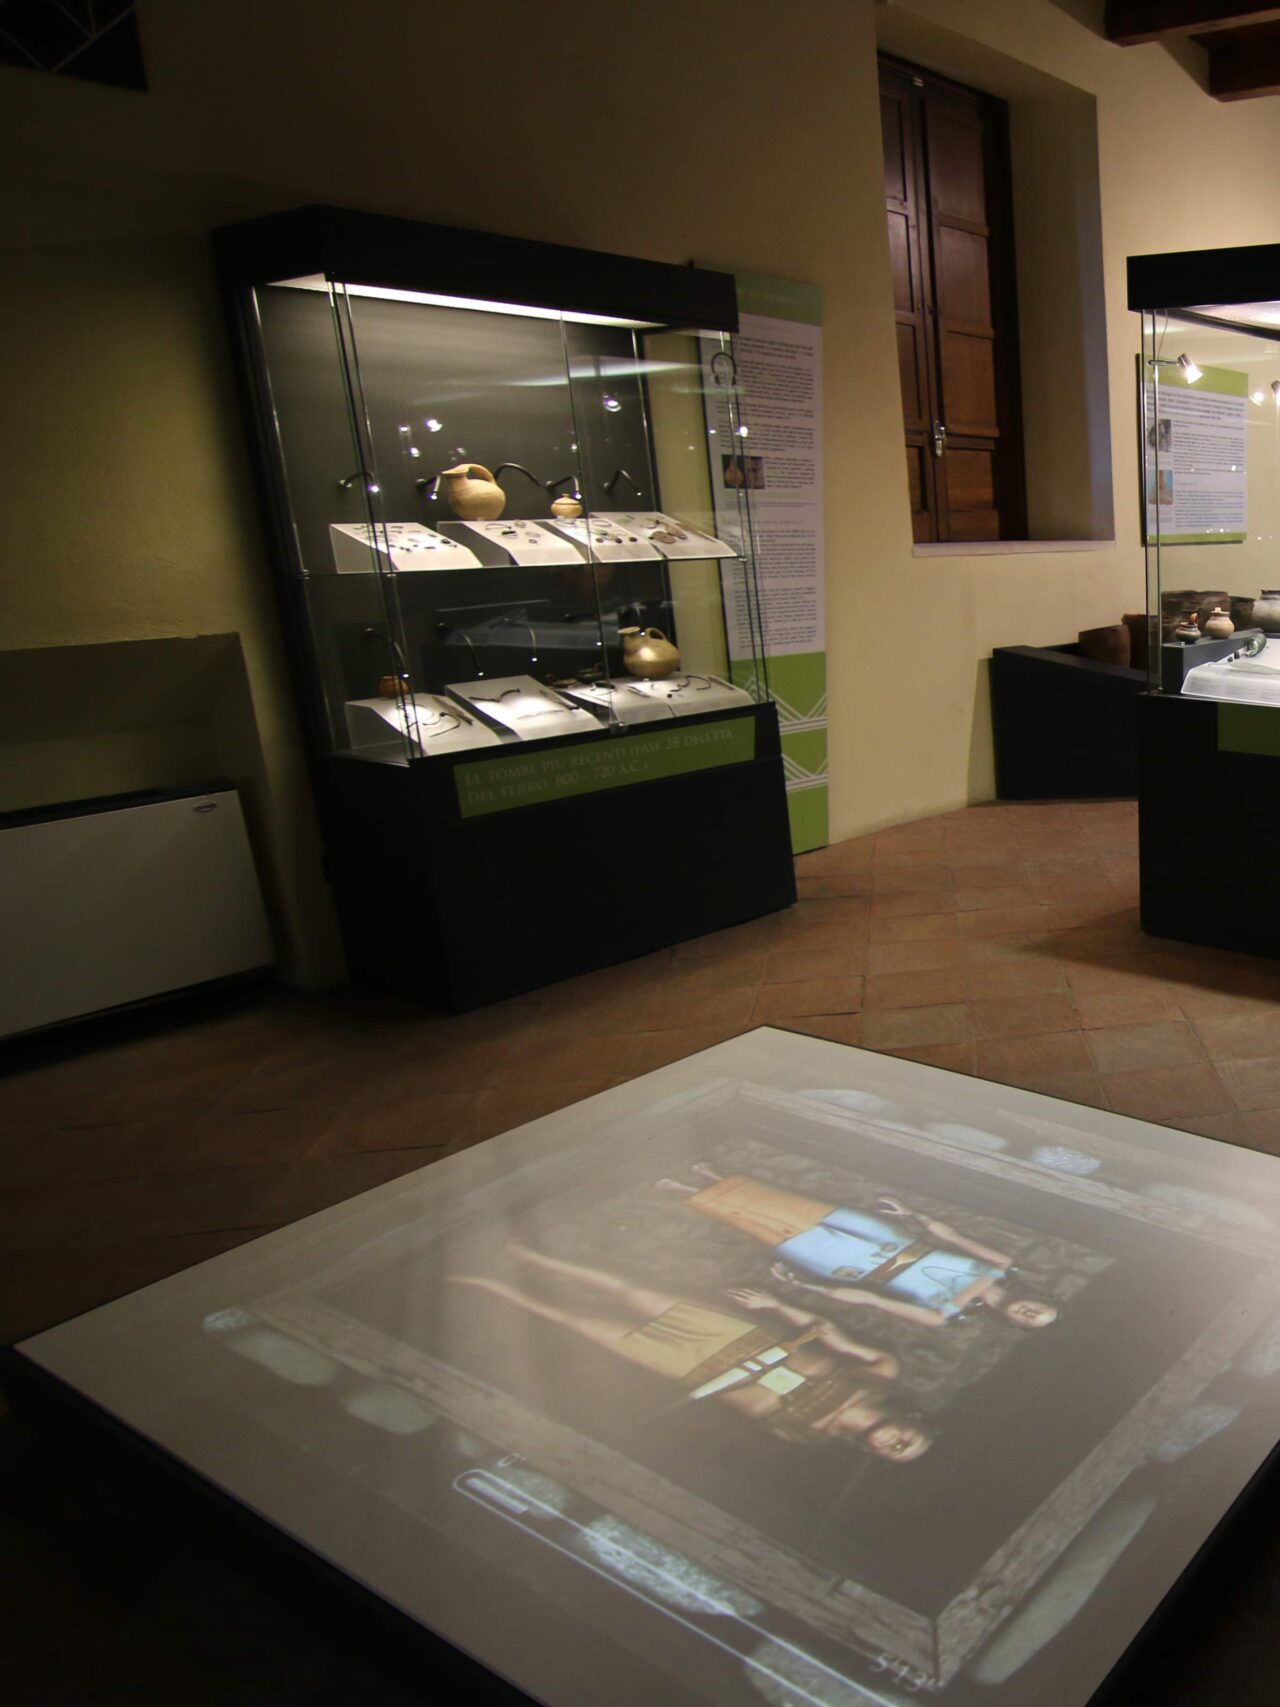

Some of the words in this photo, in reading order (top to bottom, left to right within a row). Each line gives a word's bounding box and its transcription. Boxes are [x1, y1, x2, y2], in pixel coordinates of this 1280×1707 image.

[464, 770, 482, 787] LE
[487, 762, 537, 782] TOMBE
[570, 747, 626, 767] RECENTI
[555, 770, 580, 787] 800
